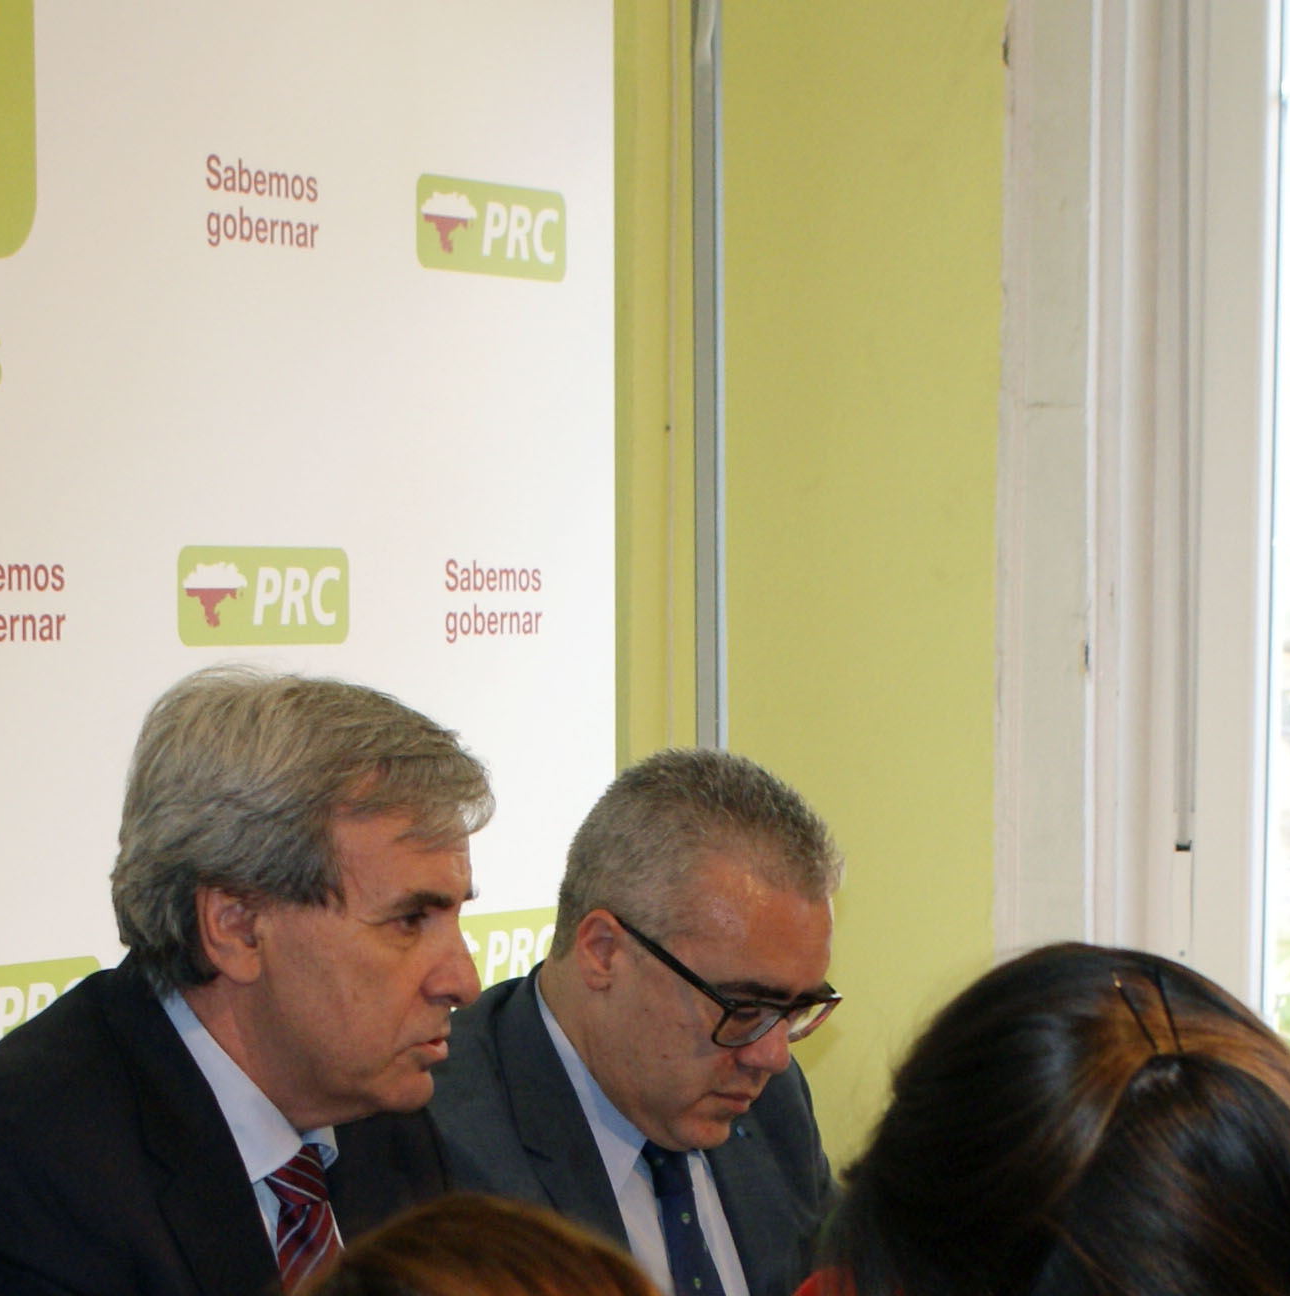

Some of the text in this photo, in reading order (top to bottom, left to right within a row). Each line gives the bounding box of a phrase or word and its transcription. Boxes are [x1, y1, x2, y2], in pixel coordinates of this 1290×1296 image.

[204, 154, 318, 204] Sabemos
[205, 207, 319, 251] gobernar
[481, 202, 560, 265] PRC
[252, 566, 341, 627] PRC
[444, 559, 542, 593] Sabemos
[444, 605, 542, 645] gobernar
